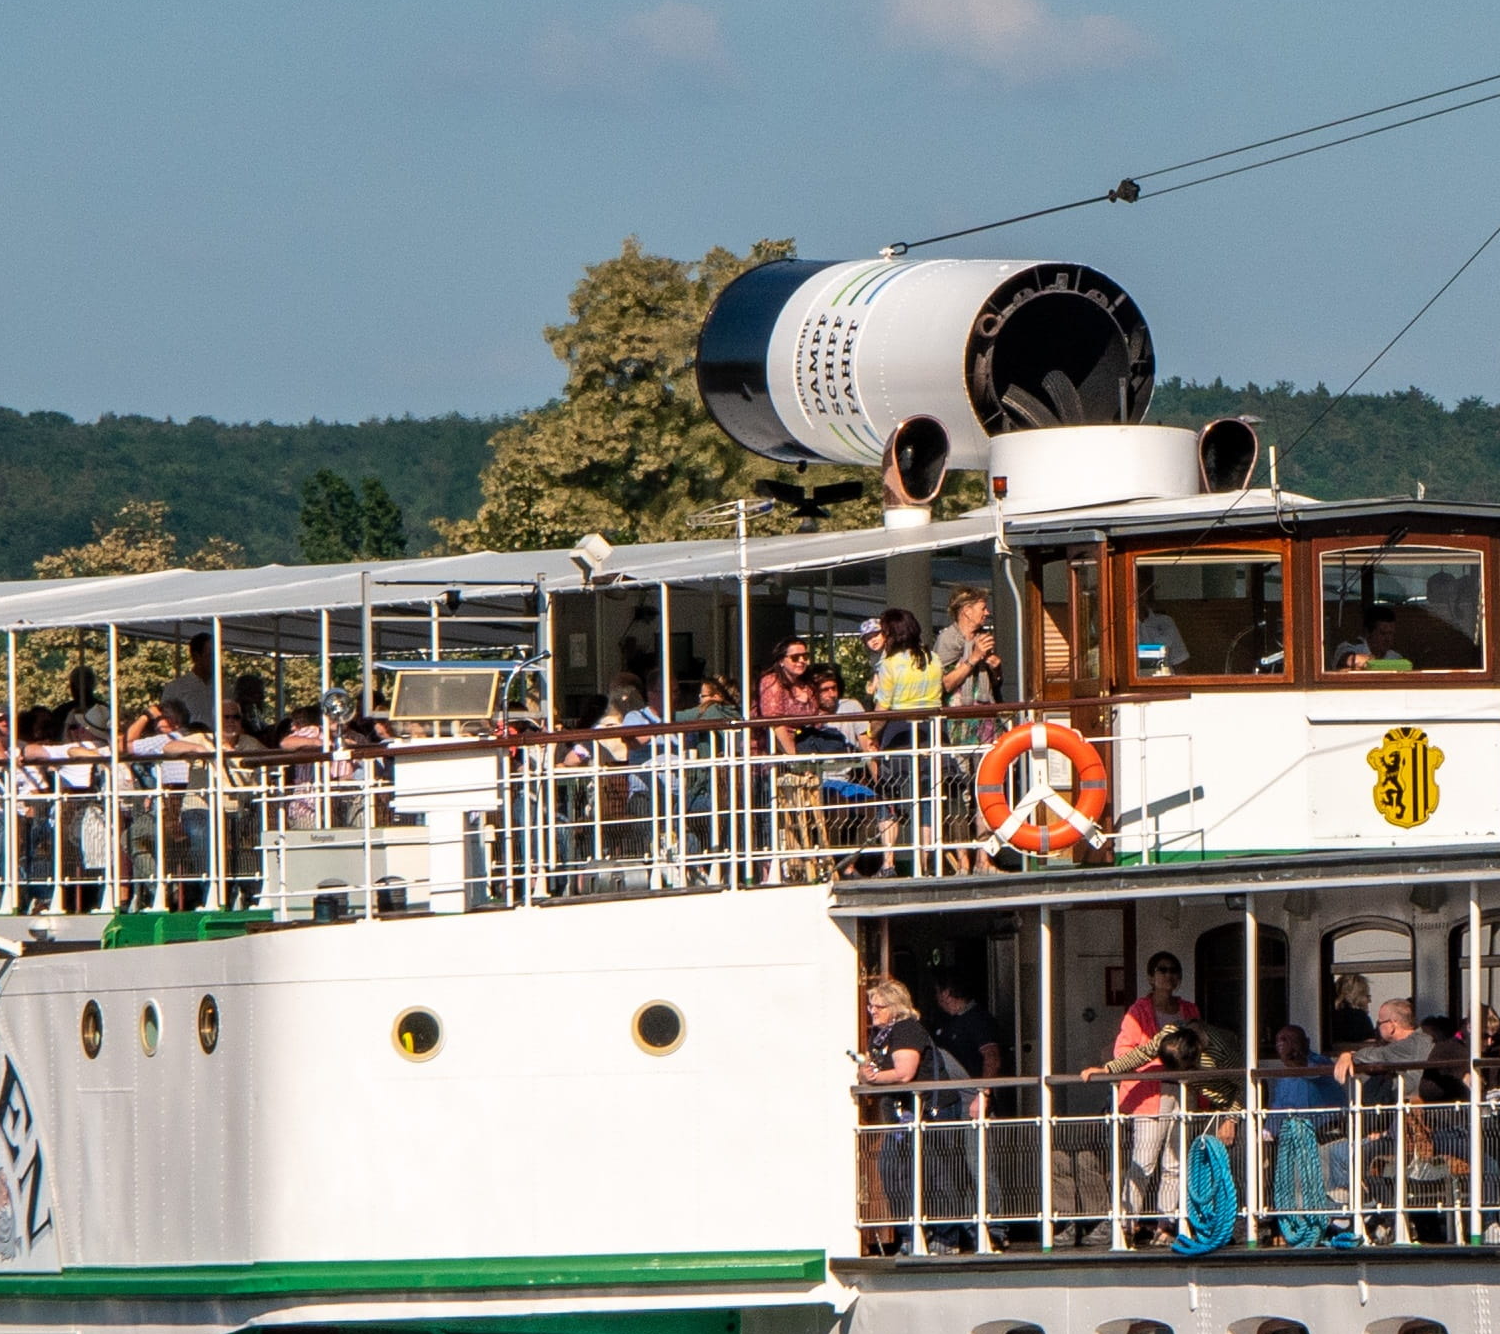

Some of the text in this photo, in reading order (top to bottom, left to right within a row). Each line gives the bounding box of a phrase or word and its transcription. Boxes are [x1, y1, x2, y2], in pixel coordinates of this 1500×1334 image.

[809, 313, 828, 415] DAMPF
[825, 315, 844, 416] SCHIFF
[841, 319, 860, 416] FAHRT
